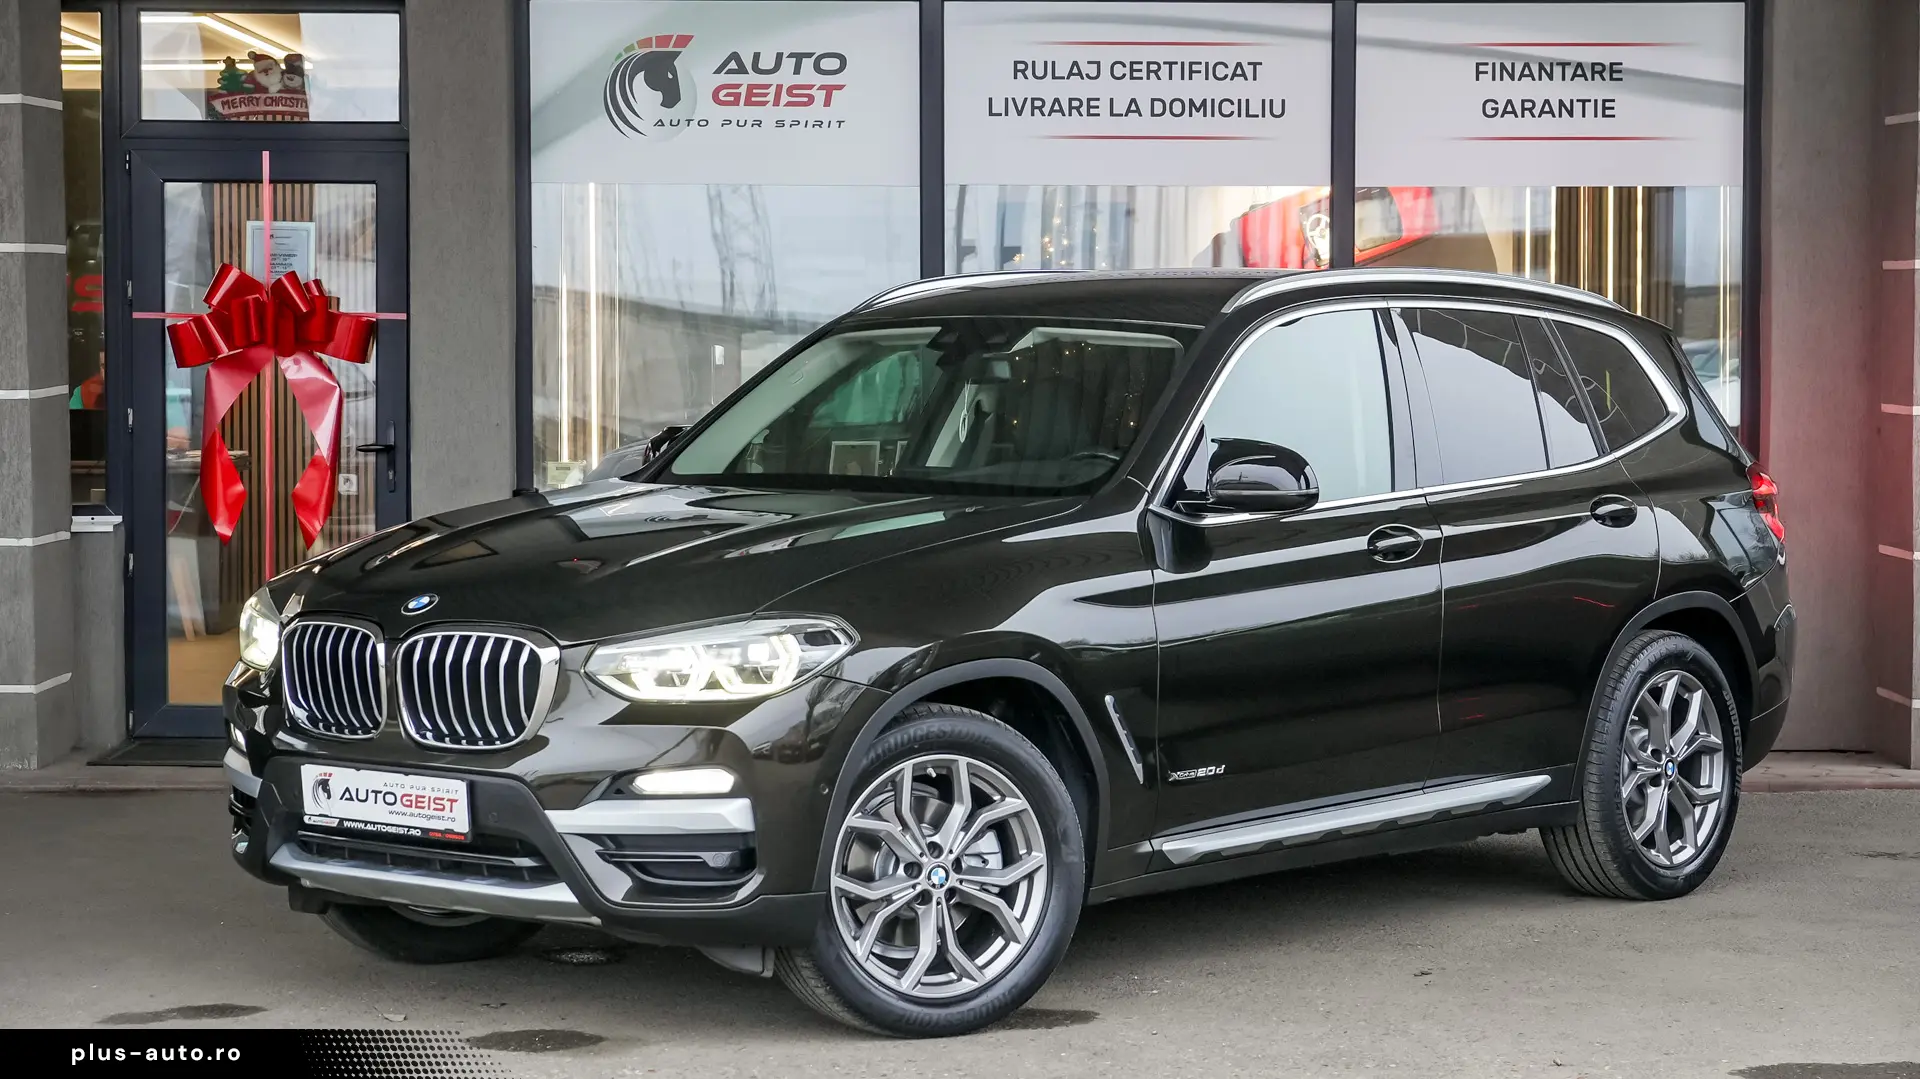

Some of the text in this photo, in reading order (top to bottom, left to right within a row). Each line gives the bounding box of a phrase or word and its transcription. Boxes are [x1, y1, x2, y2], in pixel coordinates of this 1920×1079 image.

[712, 51, 847, 76] AUTO
[1013, 60, 1263, 82] RULAJ CERTIFICAT
[1475, 61, 1624, 82] FINANTARE
[220, 96, 261, 111] MERRY
[711, 83, 847, 107] GEIST
[987, 97, 1287, 119] LIVRARE LA DOMICILIU
[1481, 98, 1616, 119] GARANTIE
[653, 118, 846, 129] AUTO PUR SPIRIT
[430, 787, 459, 795] SPIRIT
[388, 809, 456, 823] www.autogeist.ro
[343, 820, 422, 837] WWW.AUTOGEIST.RO
